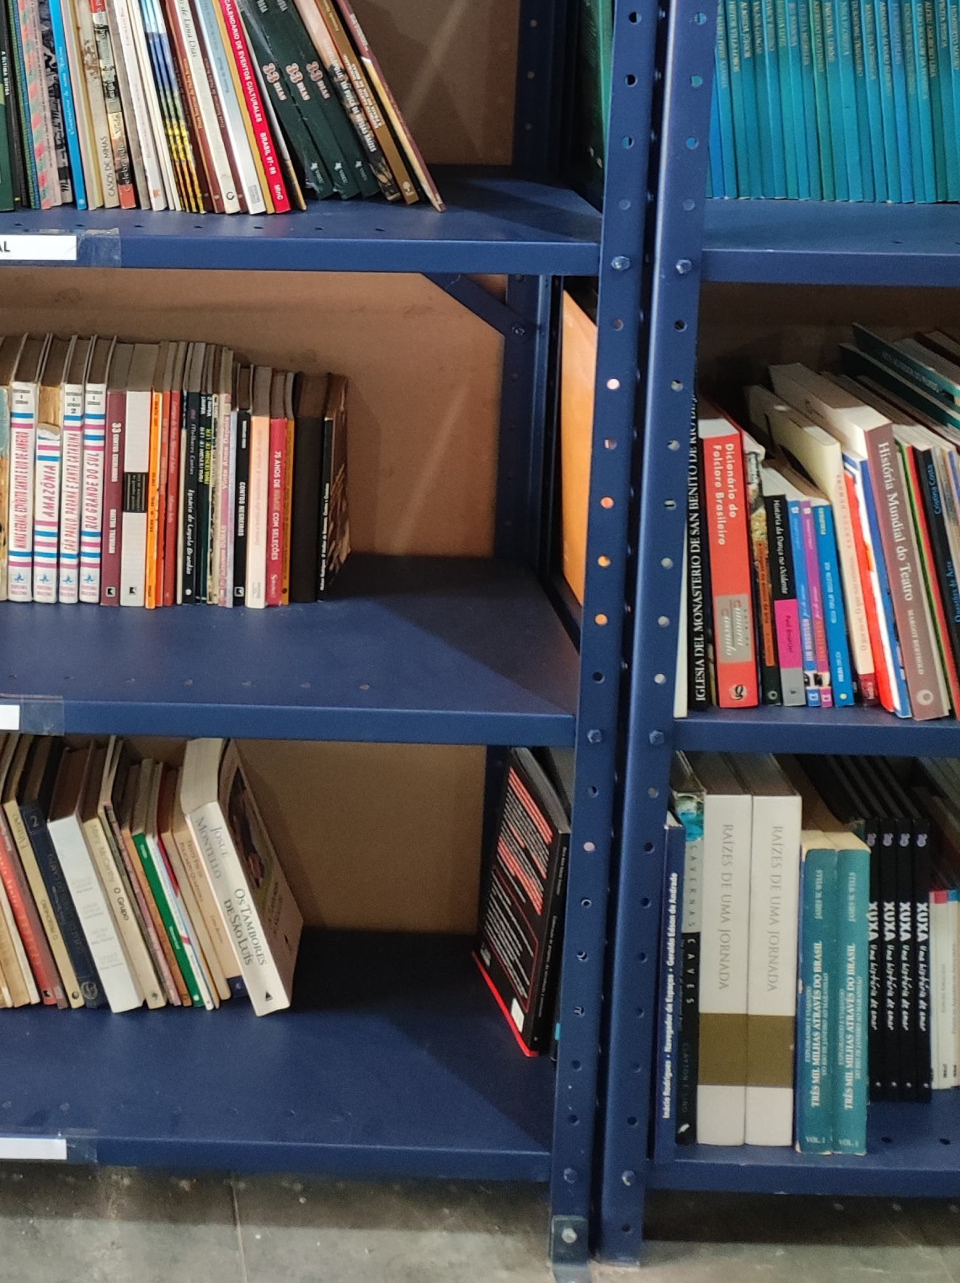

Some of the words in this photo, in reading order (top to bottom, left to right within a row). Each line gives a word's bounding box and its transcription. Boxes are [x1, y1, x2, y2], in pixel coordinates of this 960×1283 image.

[234, 40, 243, 50] DE
[237, 50, 251, 80] EVENTOS
[245, 80, 262, 122] CULTURALES
[86, 469, 98, 479] DO
[87, 452, 99, 466] SUL
[273, 459, 281, 477] ANOS
[712, 445, 724, 487] Folclore
[724, 443, 737, 499] Dicionário
[877, 441, 896, 489] História
[273, 479, 280, 487] DE
[687, 465, 698, 509] BENITO
[926, 464, 936, 485] Costa
[40, 465, 57, 517] AMAZÔNIA
[85, 482, 99, 513] GRANDE
[238, 482, 246, 504] CONTOS
[930, 486, 941, 514] Cristina
[85, 515, 97, 529] RIO
[237, 505, 245, 536] NEGREIROS
[689, 512, 699, 534] SAN
[715, 492, 727, 544] Brasileiro
[728, 503, 738, 517] do
[886, 492, 906, 542] Mundial
[270, 528, 279, 560] SELEÇÕES
[690, 537, 700, 552] DE
[895, 545, 909, 561] do
[690, 555, 703, 632] MONASTERIO
[898, 562, 916, 600] Teatro
[693, 634, 704, 657] DEL
[694, 659, 705, 700] IGLESIA
[721, 825, 733, 866] RAÍZES
[771, 826, 783, 868] RAÍZES
[112, 886, 121, 894] O
[687, 844, 697, 926] CAVERNAS
[721, 872, 731, 888] DE
[771, 874, 781, 890] DE
[116, 896, 130, 921] Grupo
[720, 894, 730, 923] UMA
[769, 896, 780, 925] UMA
[685, 938, 695, 1003] CAVES
[716, 929, 730, 989] JORNADA
[765, 931, 779, 991] JORNADA
[813, 940, 821, 972] BRASIL
[847, 943, 855, 975] BRASIL
[813, 974, 821, 987] DO
[847, 977, 855, 990] DO
[811, 989, 821, 1029] ATRAVÉS
[844, 992, 855, 1032] ATRAVÉS
[812, 1031, 820, 1064] MILHAS
[845, 1034, 854, 1067] MILHAS
[845, 1071, 853, 1086] MIL
[811, 1084, 819, 1107] TRÊS
[844, 1087, 853, 1109] TRÊS
